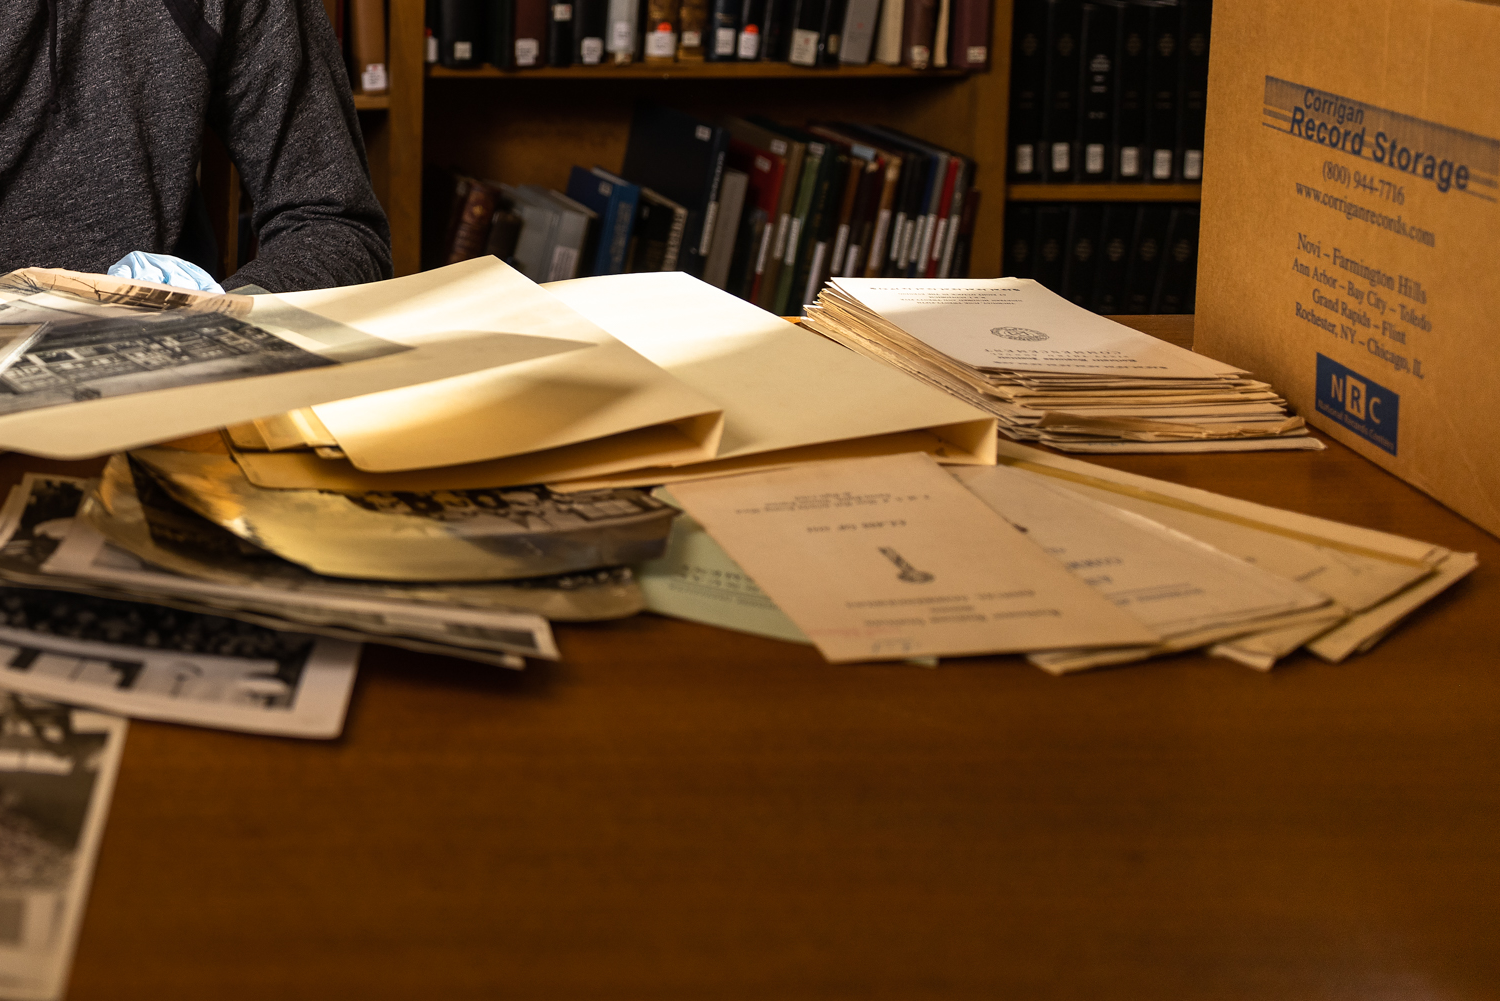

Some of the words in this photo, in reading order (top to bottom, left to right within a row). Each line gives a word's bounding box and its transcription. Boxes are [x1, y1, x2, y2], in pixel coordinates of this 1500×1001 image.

[1303, 88, 1365, 125] Corrigan
[1290, 105, 1366, 156] Record
[1372, 130, 1470, 193] Storage
[1322, 160, 1351, 189] (800)
[1353, 170, 1406, 206] 944-7716
[1296, 182, 1436, 248] www.corriganrecords.com
[1292, 257, 1310, 277] Ann
[1312, 266, 1337, 290] Arbor
[1347, 280, 1365, 305] Bay
[1366, 290, 1388, 315] City
[1398, 303, 1432, 333] Toledo
[1297, 232, 1321, 259] Novi
[1332, 247, 1395, 291] Farmington
[1398, 274, 1427, 304] Hills
[1295, 301, 1338, 338] Rochester,
[1340, 323, 1358, 345] NY
[1366, 337, 1411, 374] Chicago,
[1412, 358, 1425, 380] IL
[1312, 288, 1339, 316] Grand
[1341, 301, 1371, 329] Rapids
[1381, 320, 1406, 345] Flint
[1317, 399, 1344, 421] National
[1331, 373, 1383, 425] NRC
